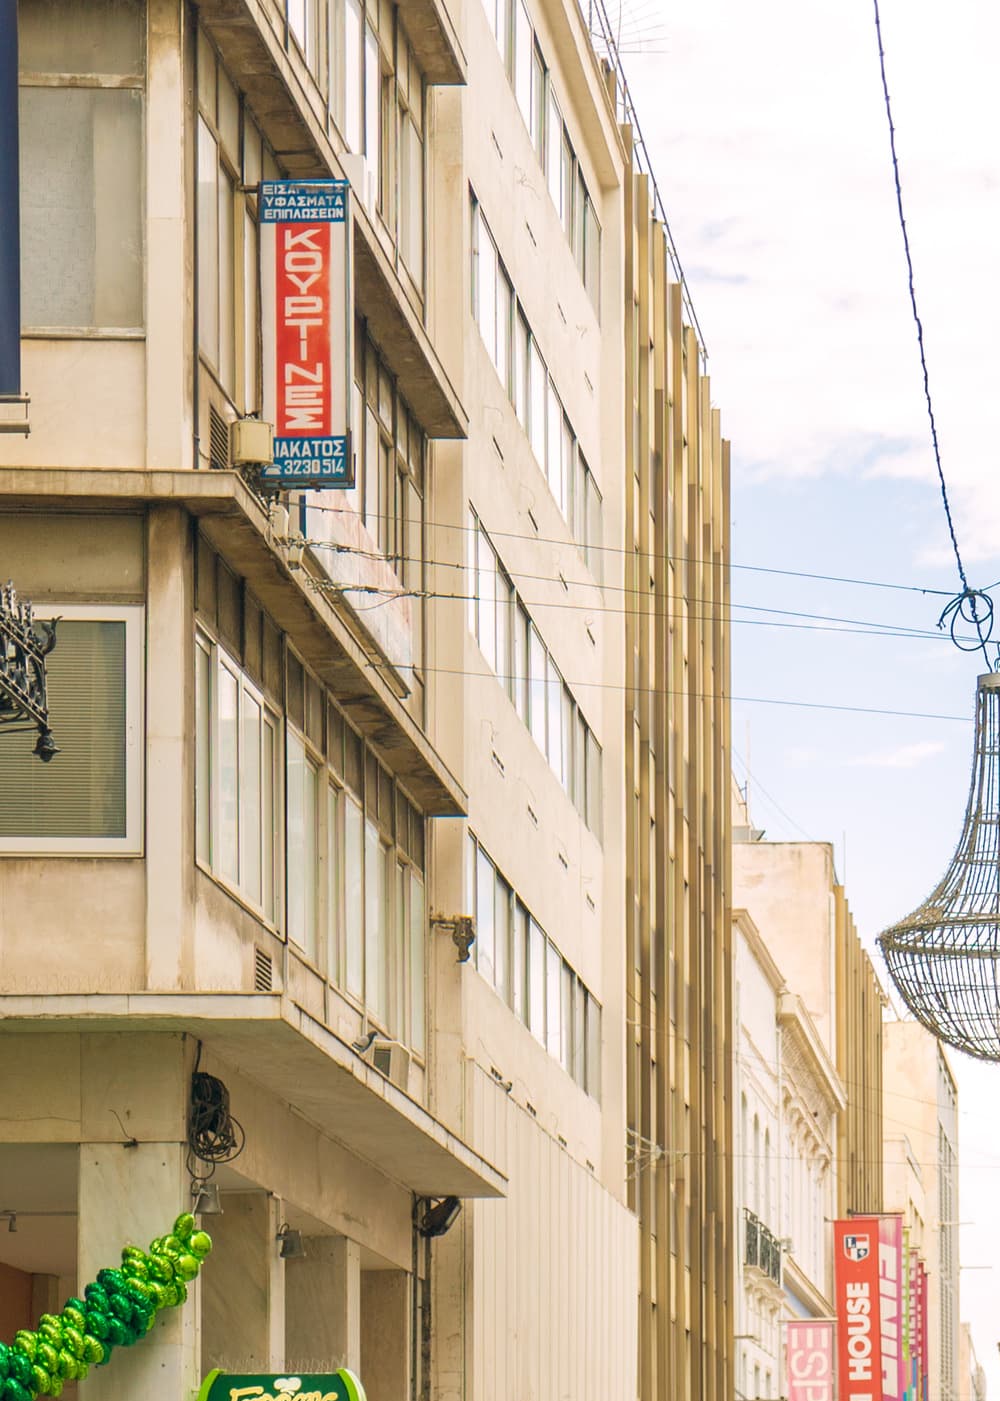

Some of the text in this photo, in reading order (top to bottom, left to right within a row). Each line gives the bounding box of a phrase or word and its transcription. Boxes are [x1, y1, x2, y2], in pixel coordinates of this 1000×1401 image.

[264, 207, 344, 220] ΕΠΙΠΛΩΣΕΩΝ
[265, 196, 344, 208] ΥΦΑΣΜΑΤΑ
[285, 228, 324, 430] ΚΟΥΡΤΙΝΕΣ
[846, 1281, 873, 1381] HOUSE
